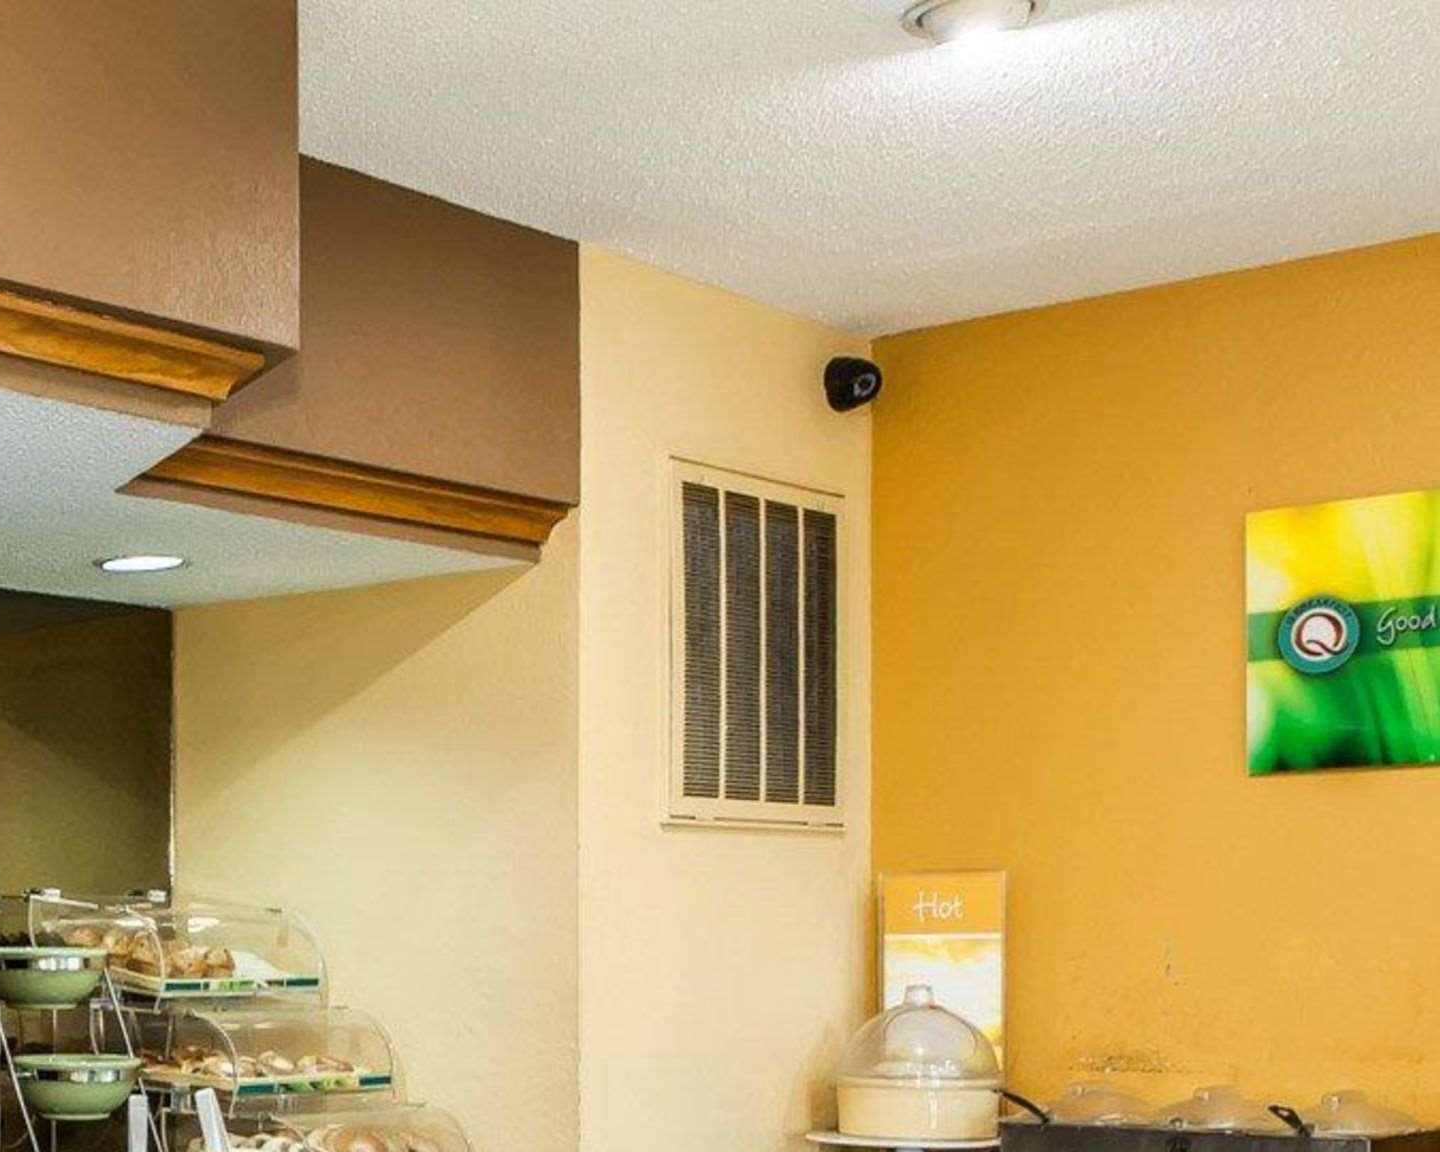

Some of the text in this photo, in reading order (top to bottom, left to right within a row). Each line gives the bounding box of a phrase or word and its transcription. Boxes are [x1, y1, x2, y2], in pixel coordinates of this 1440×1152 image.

[1294, 611, 1350, 657] Q
[1376, 604, 1437, 646] Good
[913, 888, 964, 922] Hot
